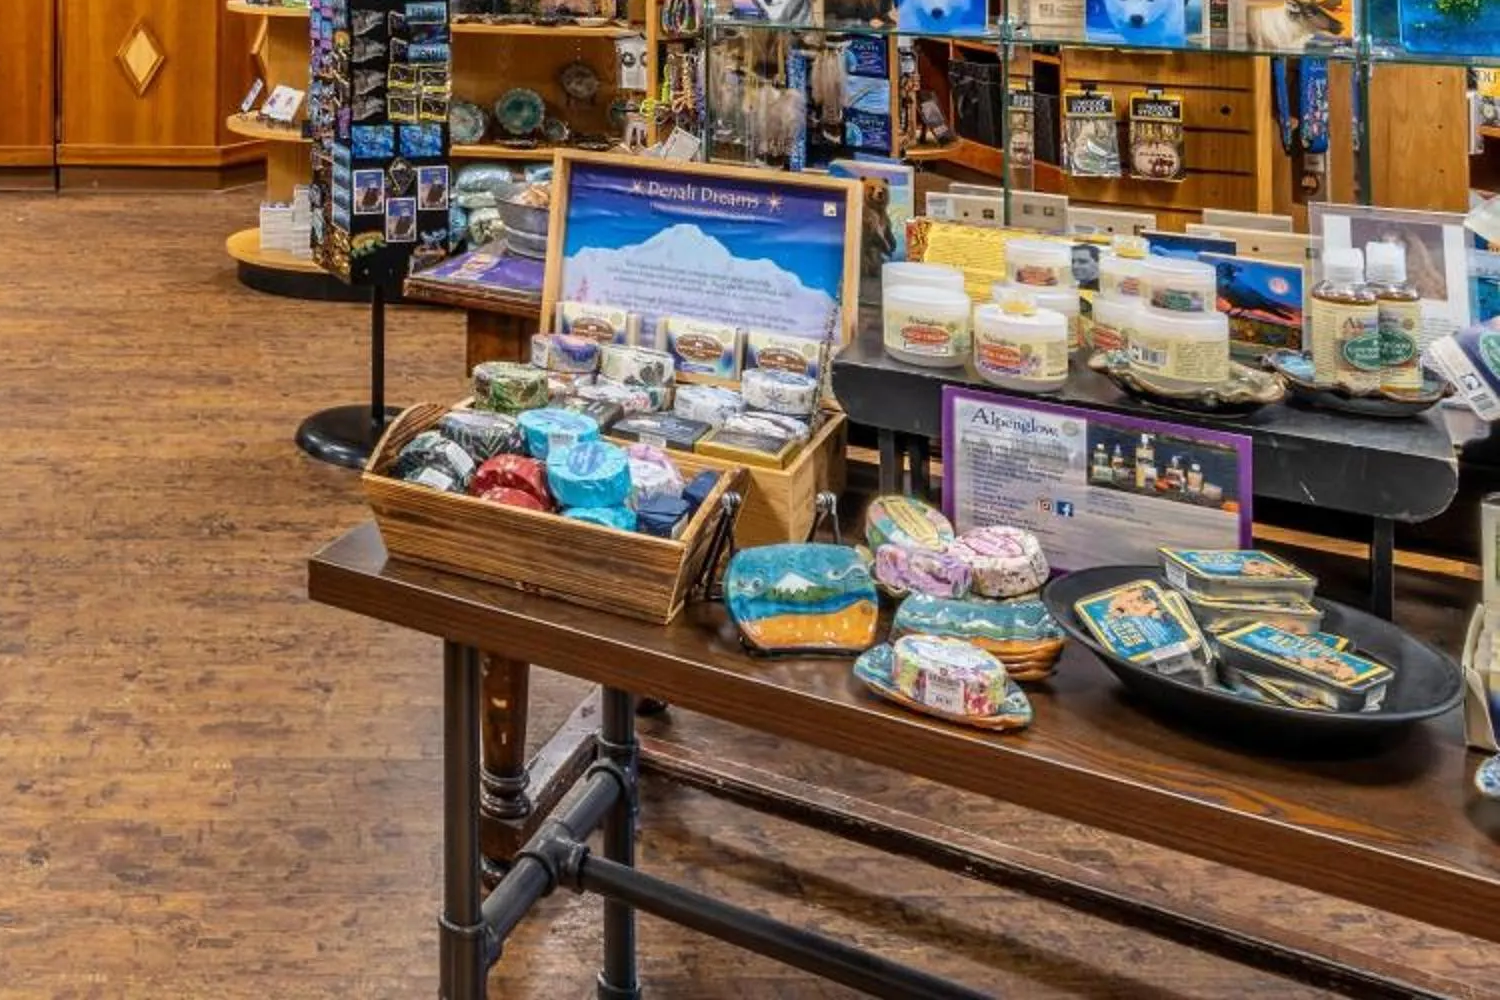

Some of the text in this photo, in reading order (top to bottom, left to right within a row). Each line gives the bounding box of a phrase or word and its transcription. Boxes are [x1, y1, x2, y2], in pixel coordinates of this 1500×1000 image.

[649, 180, 761, 209] Denali Dreams
[971, 407, 1058, 438] Alpenglow
